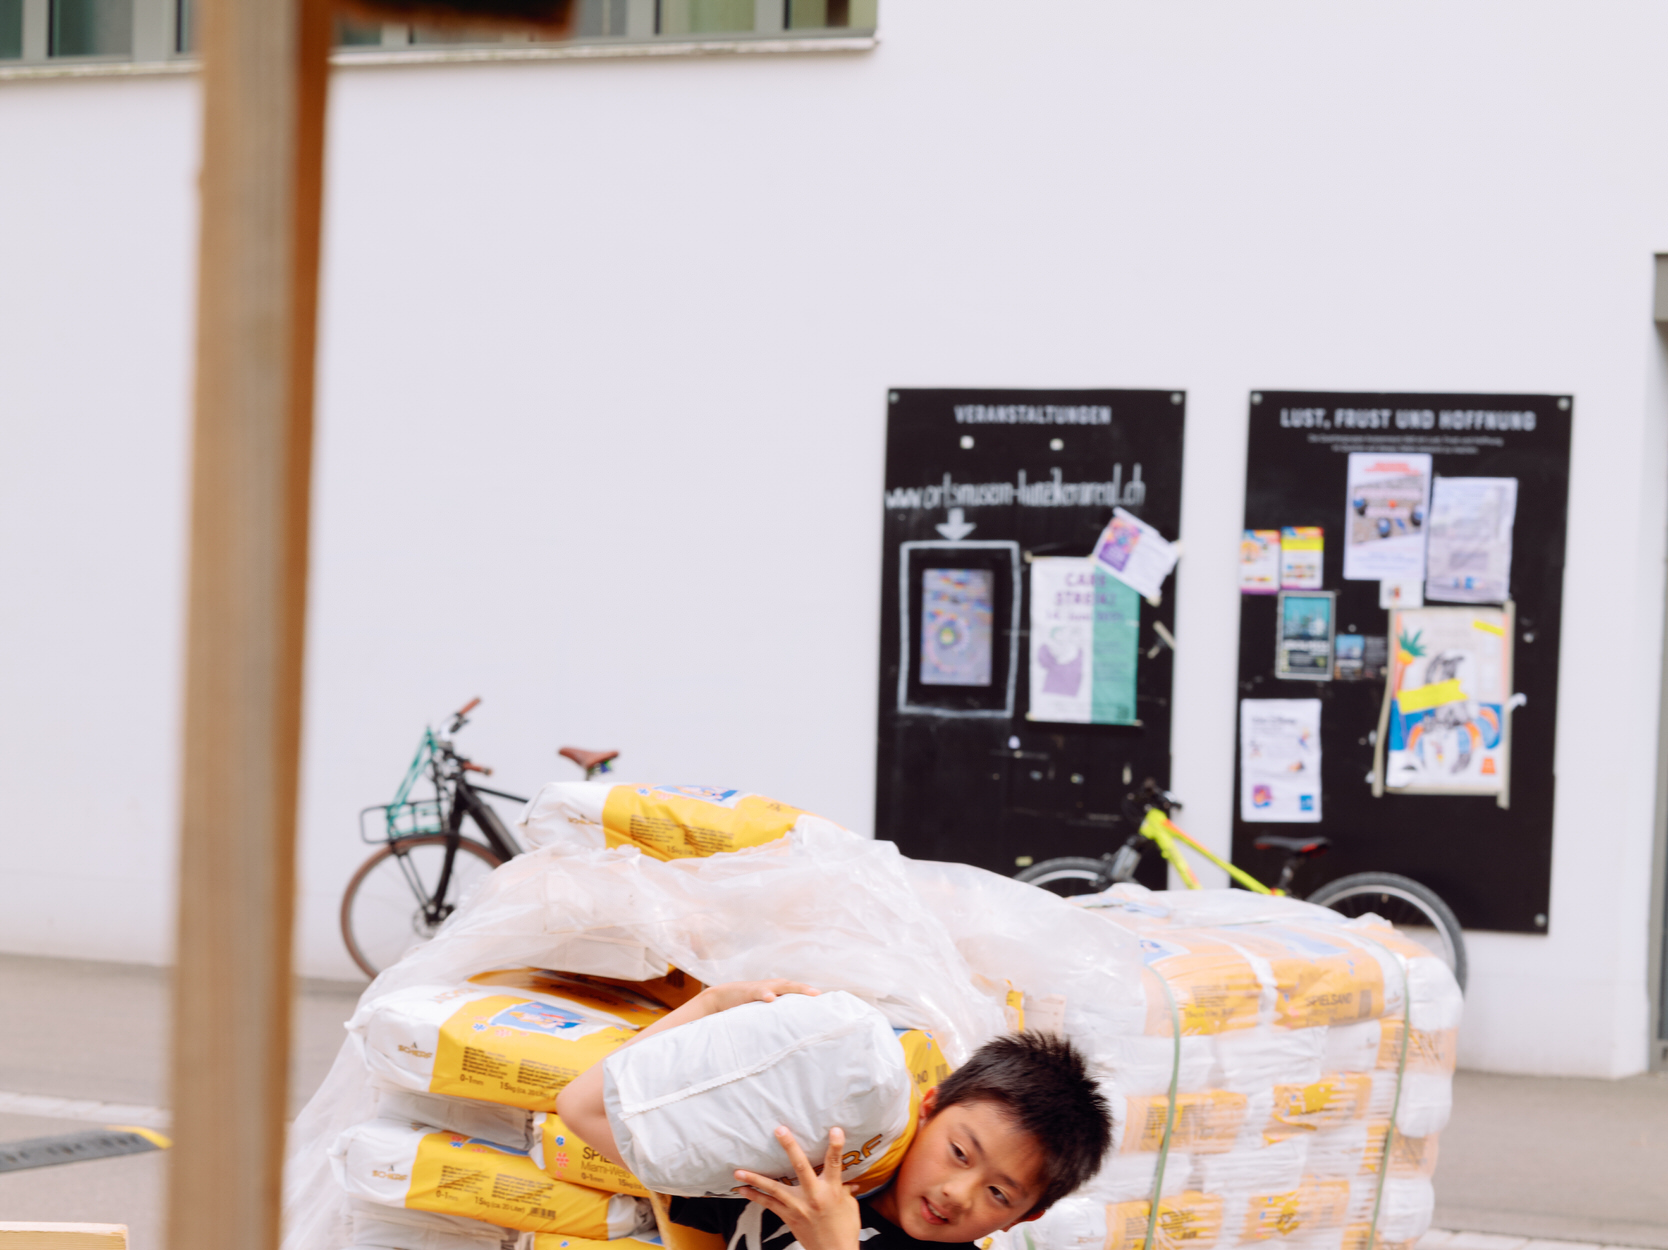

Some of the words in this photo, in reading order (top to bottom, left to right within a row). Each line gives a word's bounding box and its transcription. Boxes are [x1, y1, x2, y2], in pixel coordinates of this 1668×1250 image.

[954, 405, 1112, 424] VERANSTALTUNGEN
[1280, 408, 1331, 430] LUST,
[1334, 408, 1392, 430] FRUST
[1395, 409, 1435, 430] UND
[1438, 410, 1537, 432] HOFFNUNG
